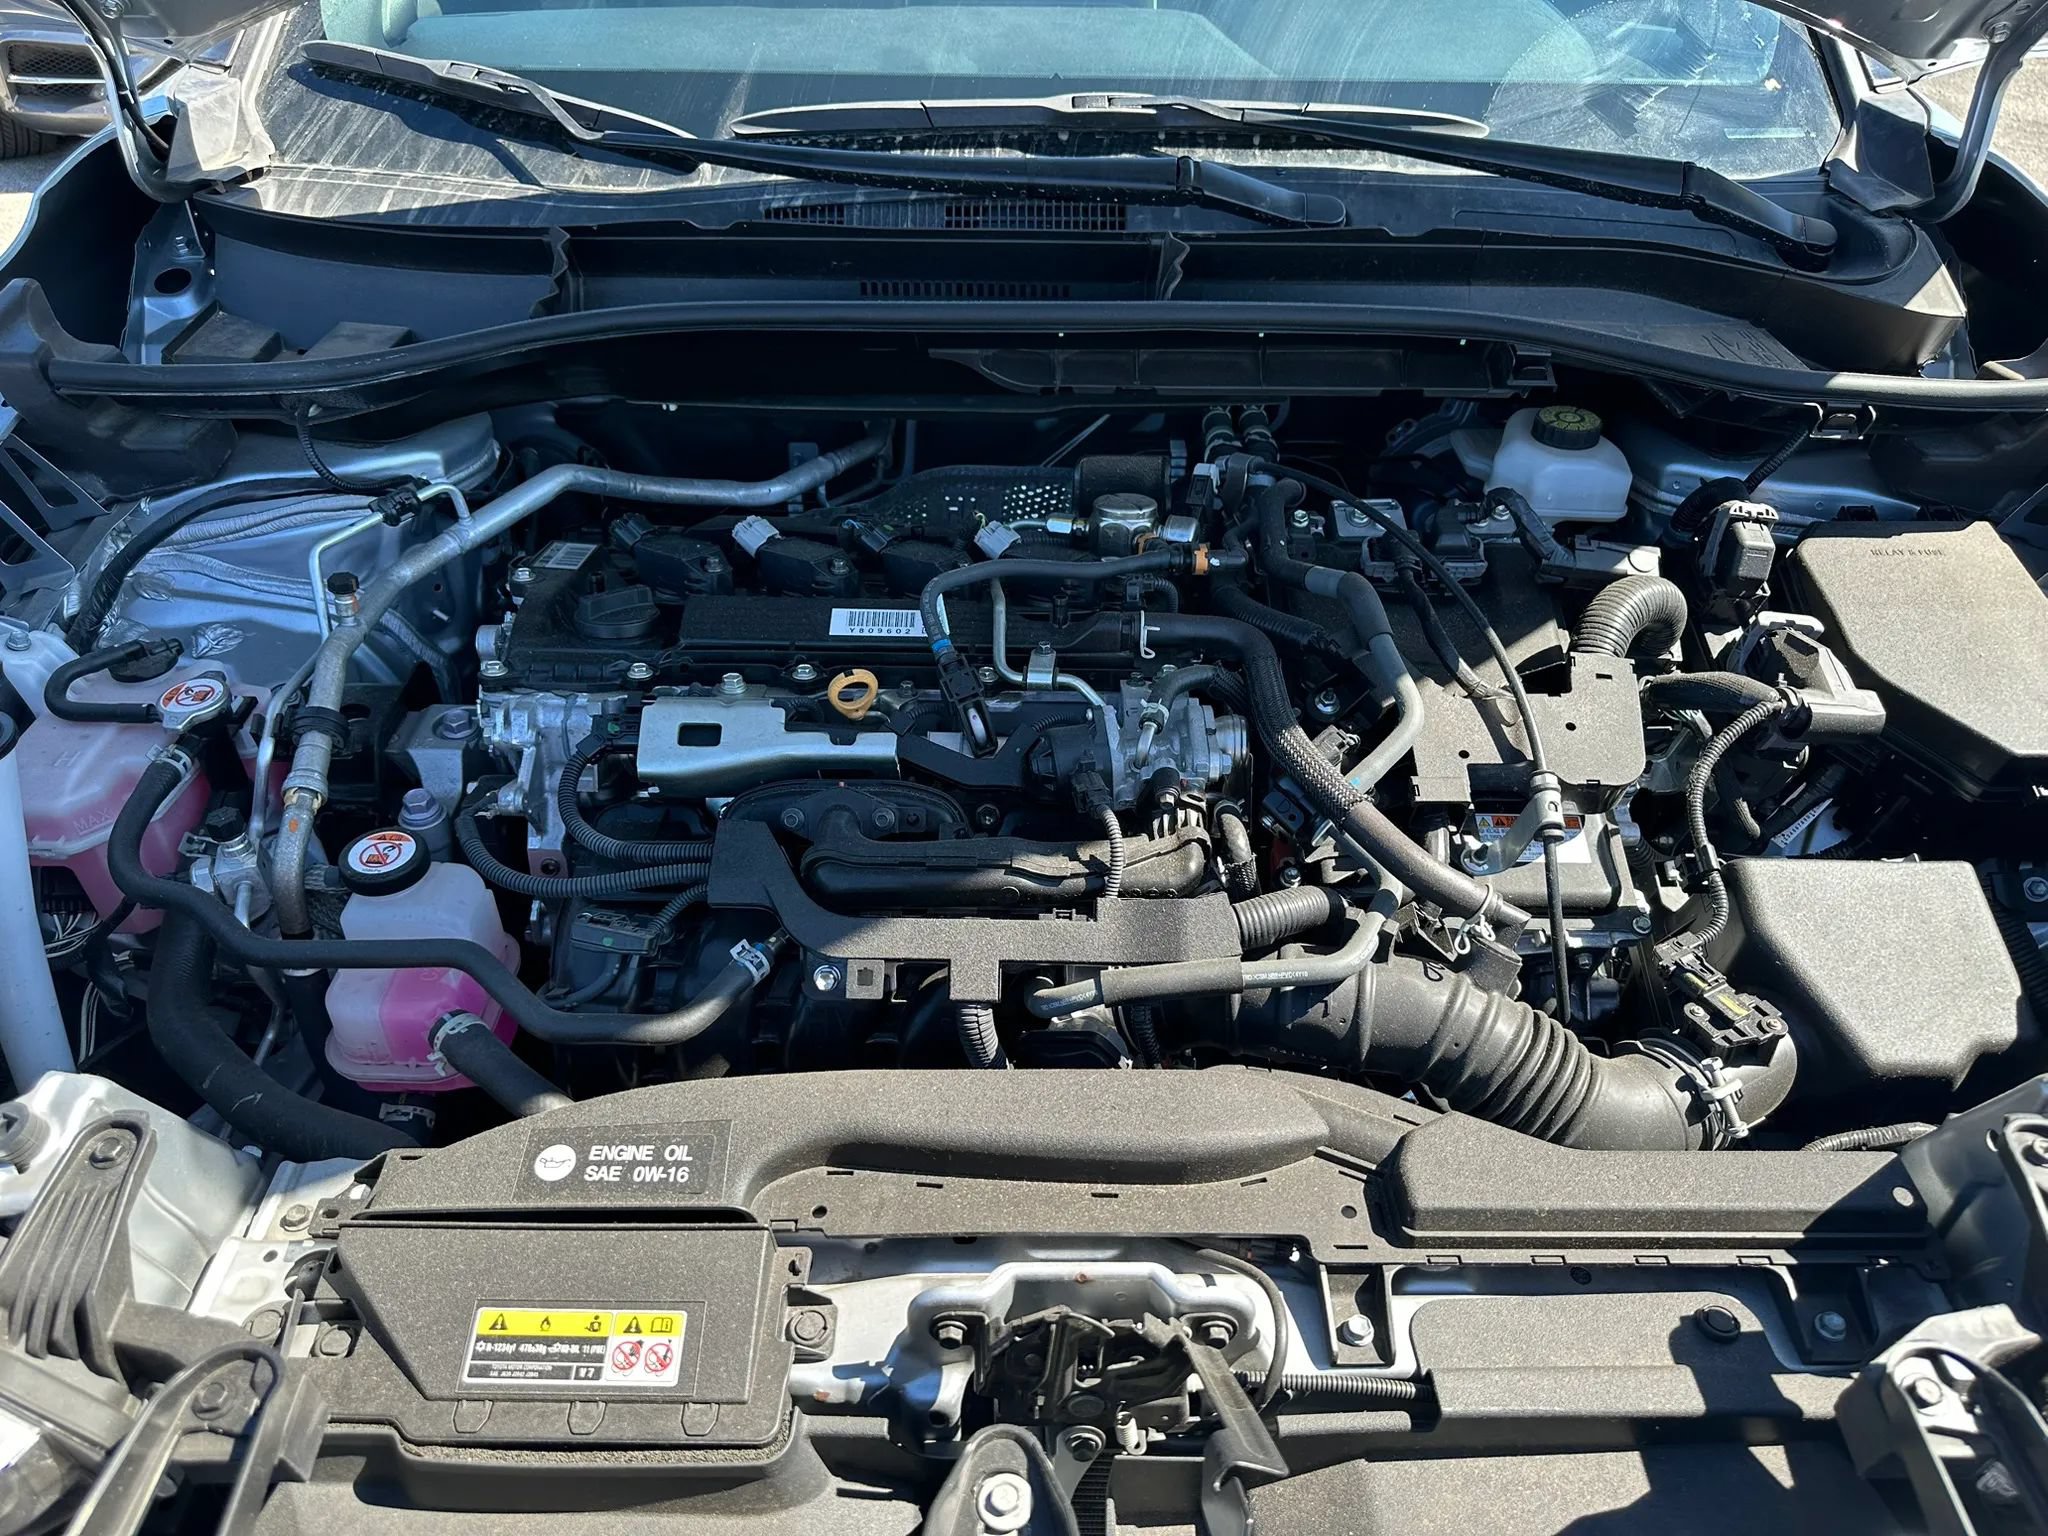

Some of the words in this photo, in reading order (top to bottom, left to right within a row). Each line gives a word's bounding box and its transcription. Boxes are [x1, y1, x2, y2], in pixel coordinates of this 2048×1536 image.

[850, 627, 911, 635] Y809602
[588, 1145, 655, 1161] ENGINE
[664, 1144, 693, 1161] OIL
[584, 1165, 622, 1182] SAE
[632, 1166, 690, 1183] 0W-16
